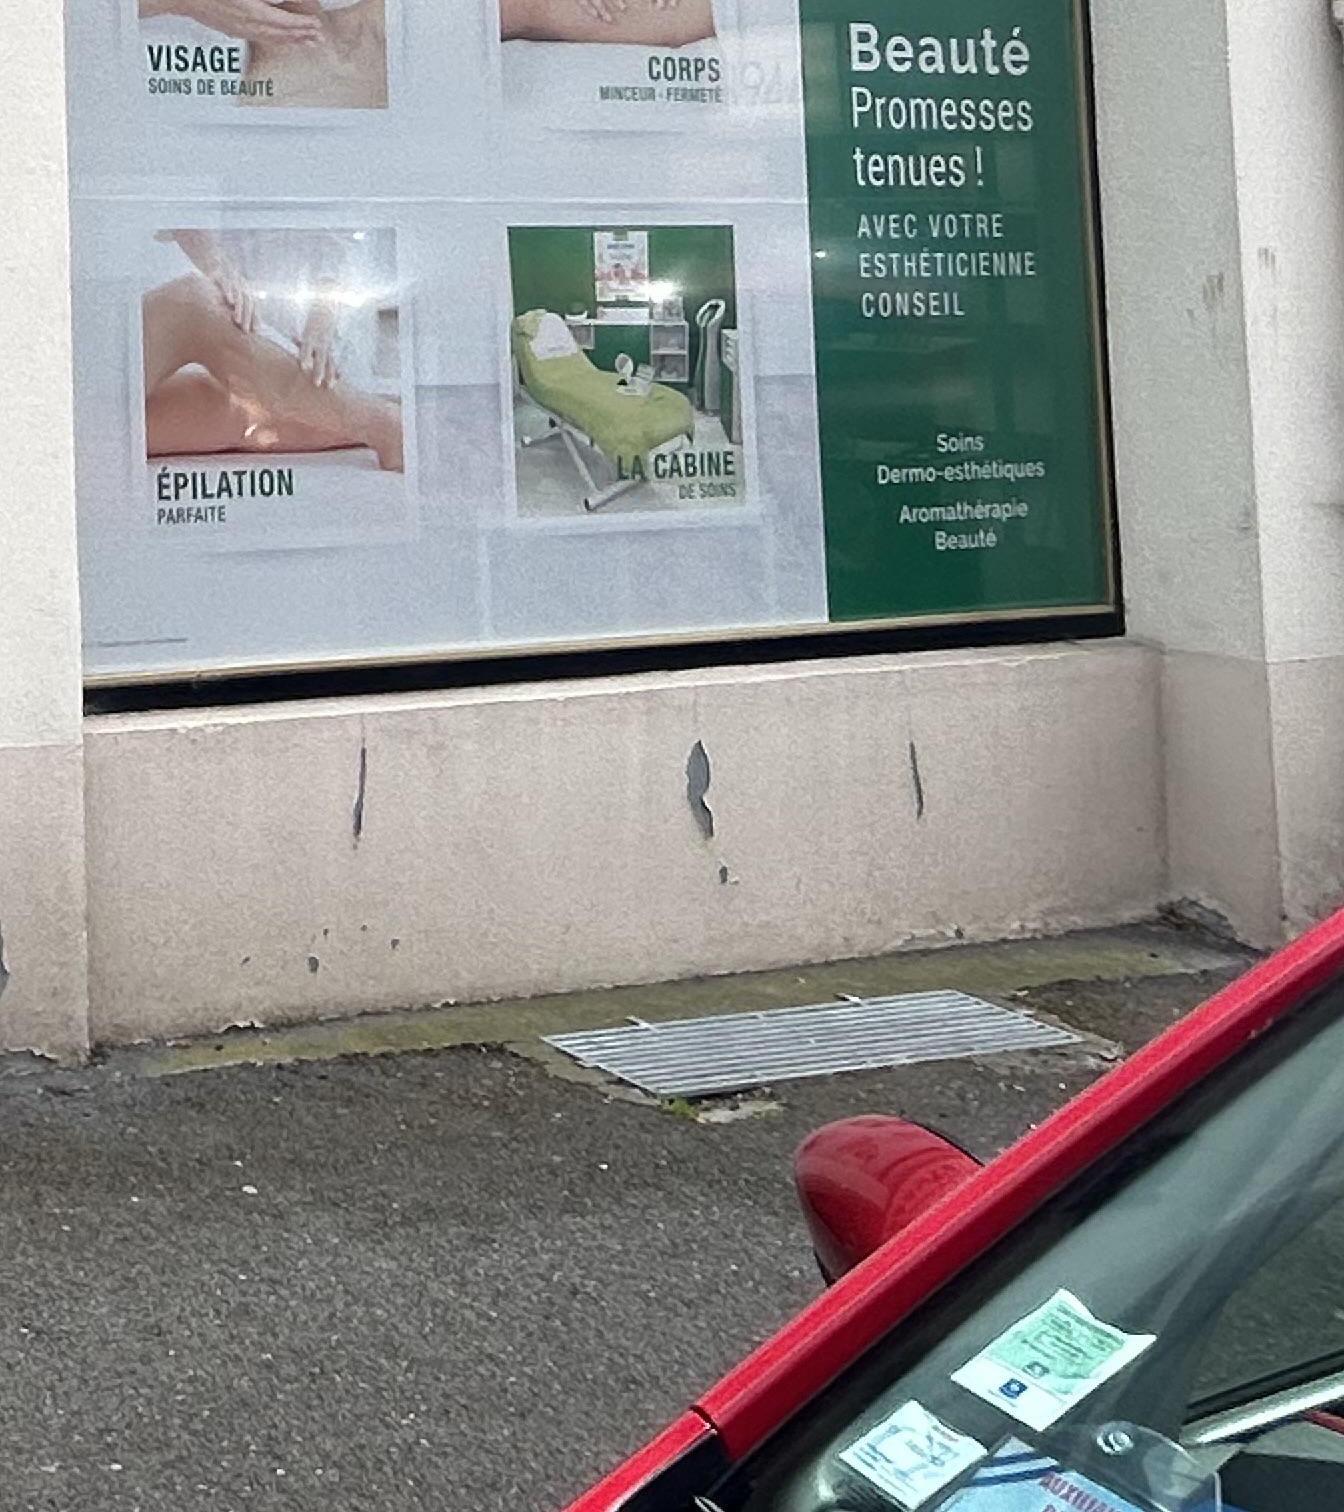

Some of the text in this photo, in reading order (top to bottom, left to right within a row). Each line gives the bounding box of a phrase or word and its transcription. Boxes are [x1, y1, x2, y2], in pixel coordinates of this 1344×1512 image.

[147, 44, 241, 74] VISAGE
[849, 22, 1030, 76] Beauté
[648, 56, 721, 83] CORPS
[148, 78, 274, 96] SOINS DE BEAUTÉ
[600, 86, 655, 101] MINCEUR
[851, 86, 1034, 131] Promesses
[853, 146, 965, 187] tenues
[857, 213, 1004, 239] AVEC VOTRE
[859, 247, 1037, 278] ESTHÉTICIENNE
[862, 292, 966, 318] CONSEIL
[937, 432, 984, 453] Soins
[617, 450, 735, 480] LA CABINE
[877, 459, 1046, 485] Dermo-esthétiques
[157, 466, 294, 501] ÉPILATION
[157, 505, 226, 525] PARFAITE
[899, 499, 1029, 524] Aromathérapie
[934, 527, 997, 551] Beauté
